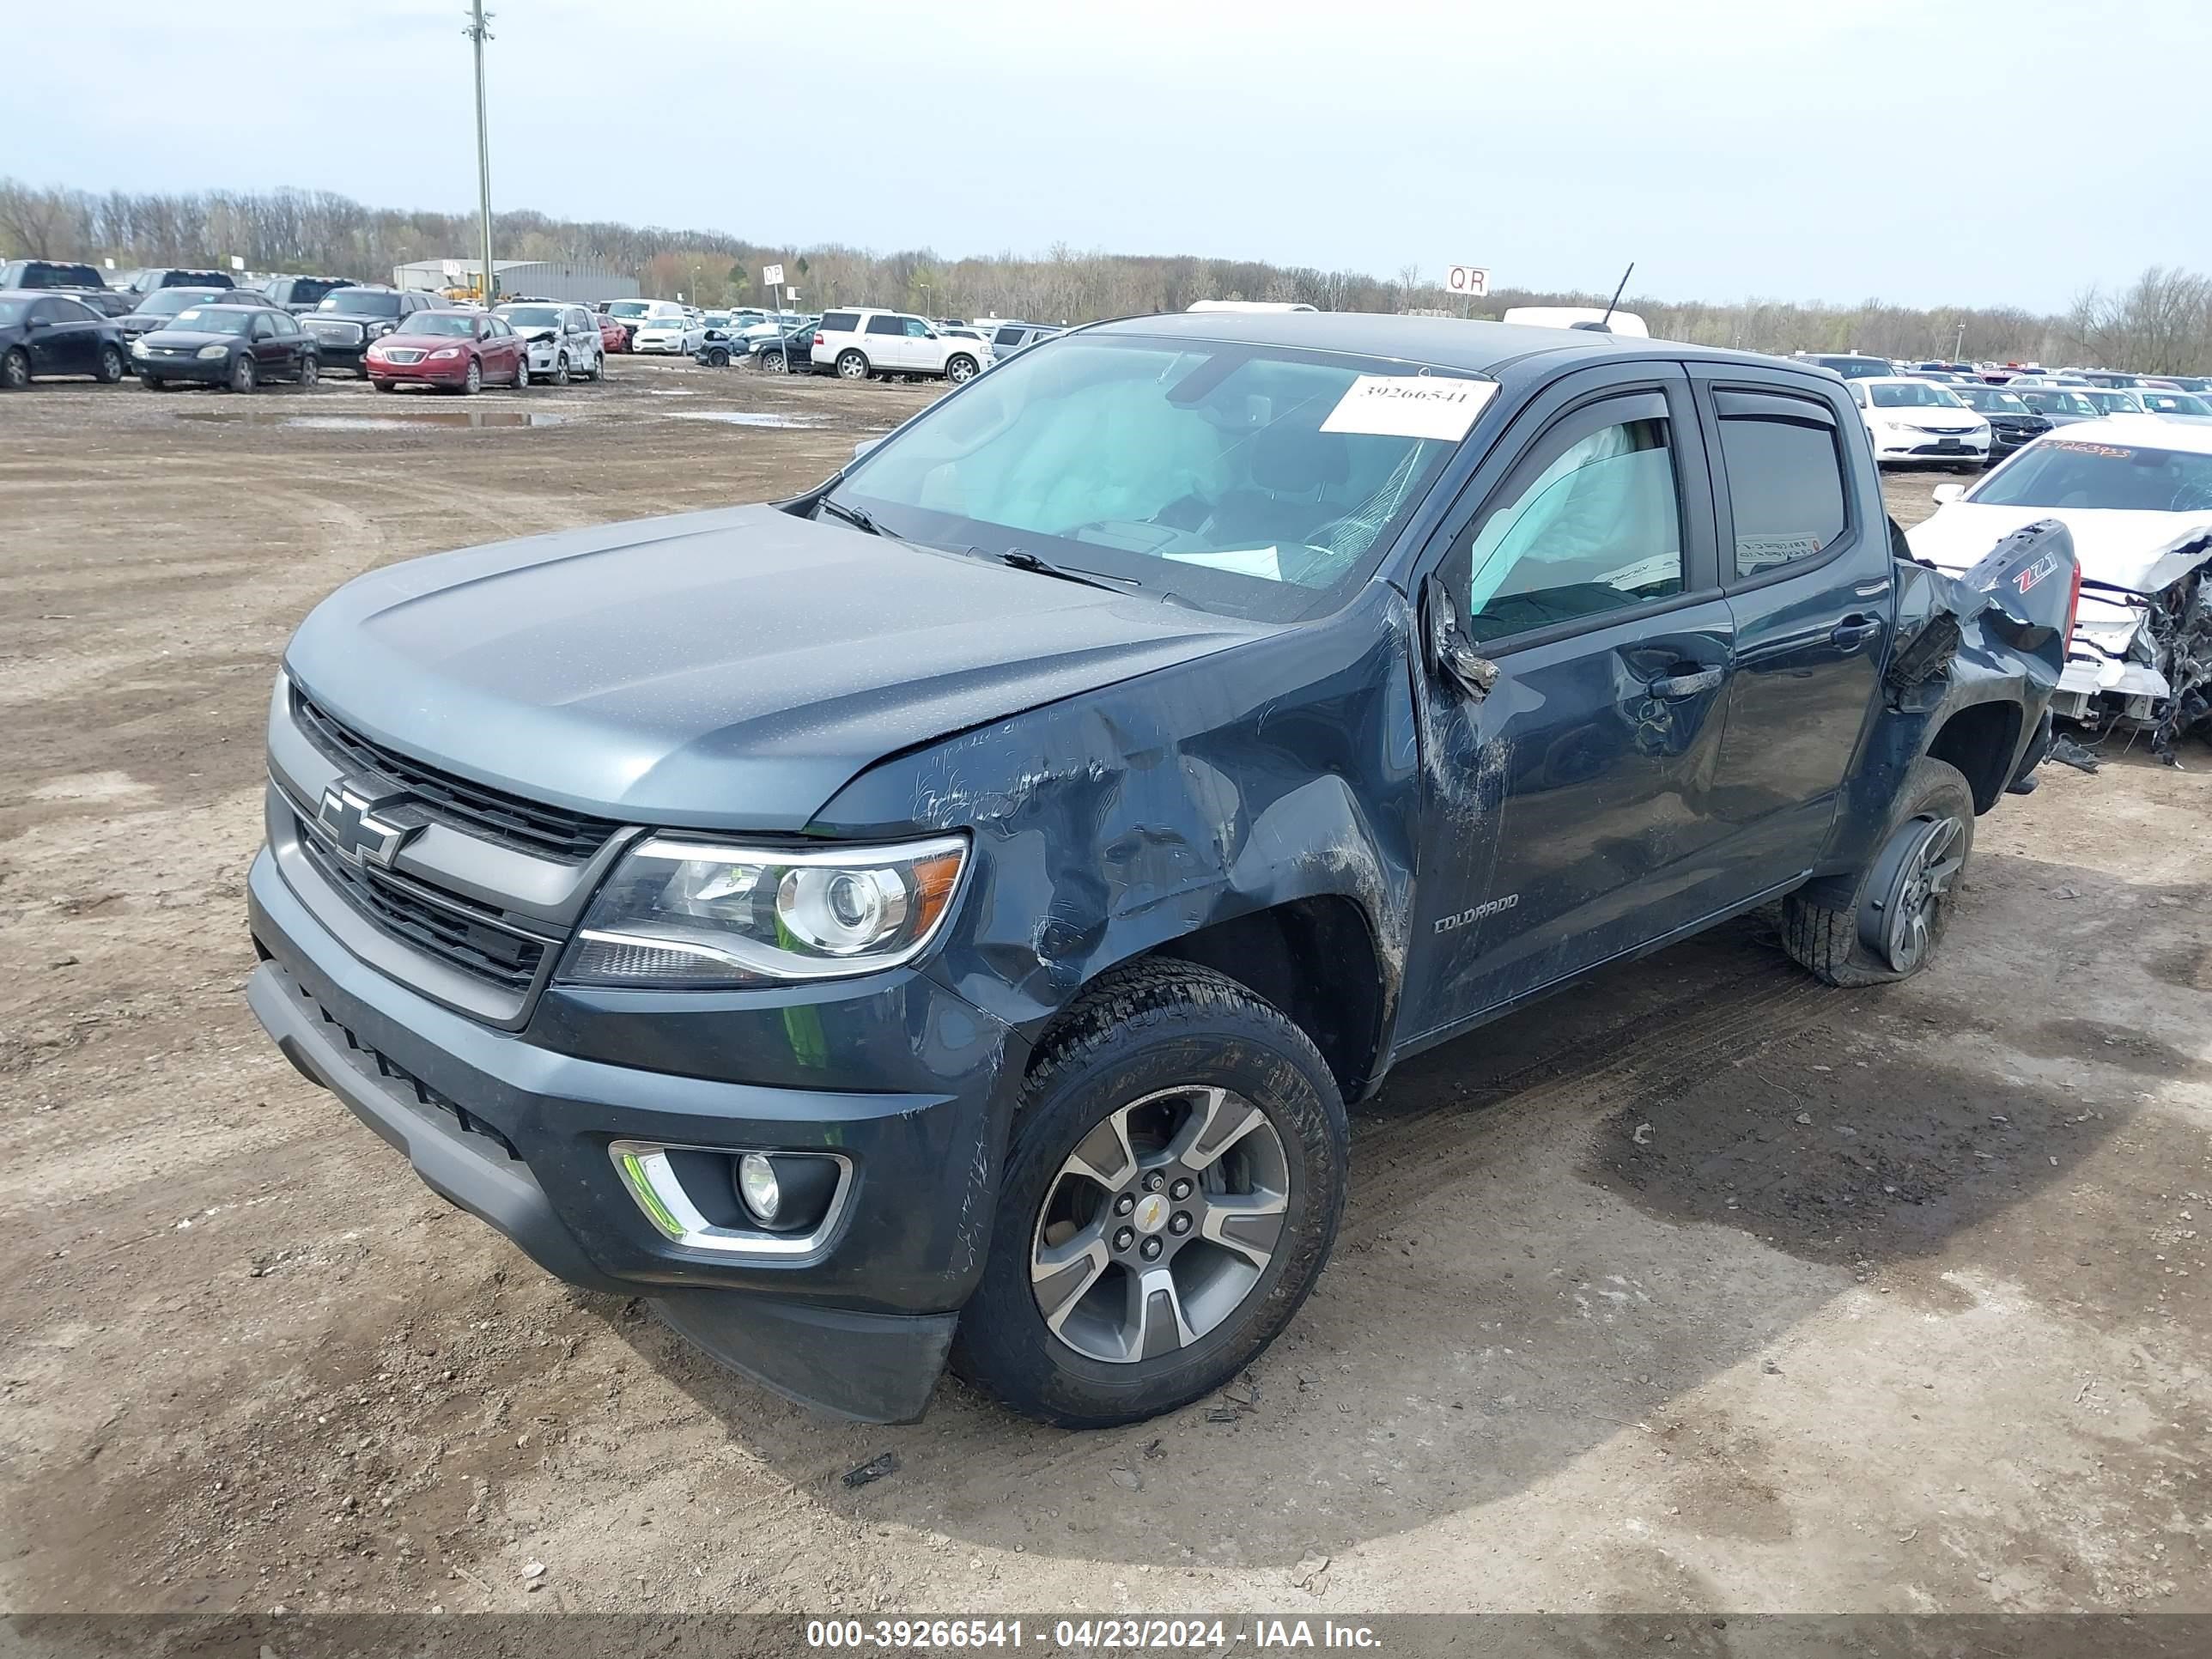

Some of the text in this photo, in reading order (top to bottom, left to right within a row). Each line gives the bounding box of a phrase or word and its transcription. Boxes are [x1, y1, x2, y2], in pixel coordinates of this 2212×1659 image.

[1451, 267, 1485, 292] QR
[1359, 386, 1471, 404] 39266541
[2012, 551, 2058, 595] Z71
[1434, 893, 1519, 934] COLORADO
